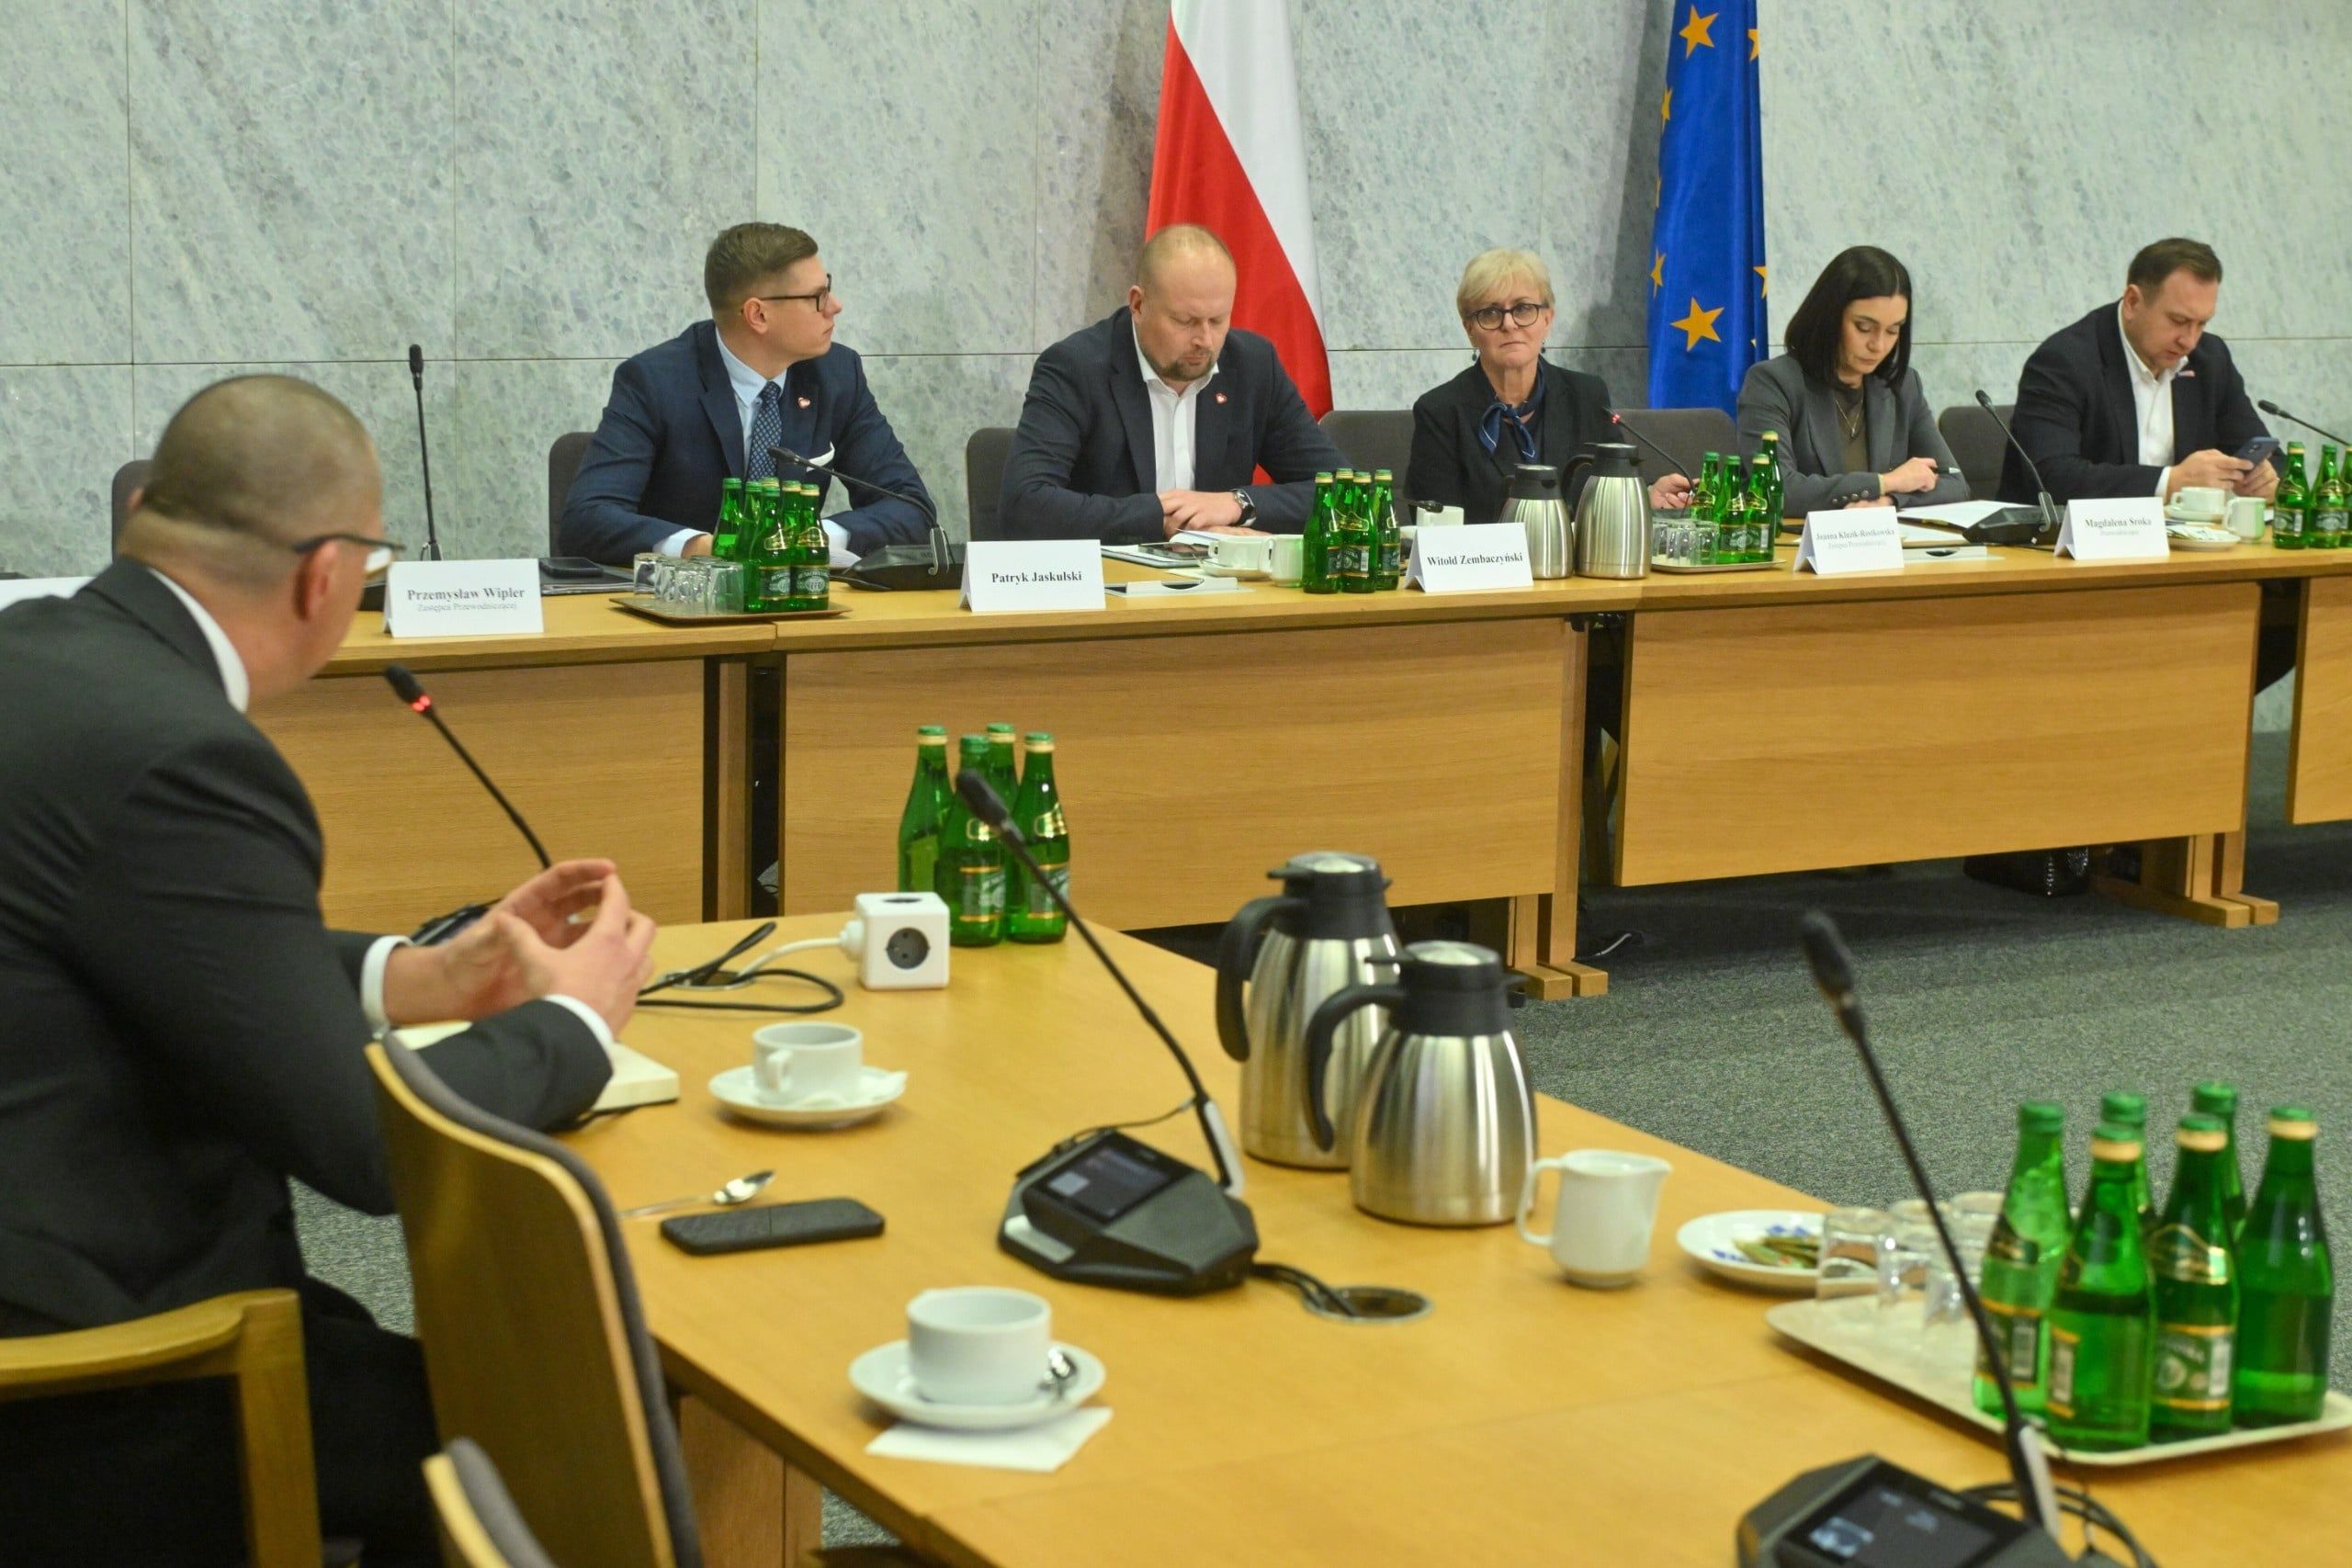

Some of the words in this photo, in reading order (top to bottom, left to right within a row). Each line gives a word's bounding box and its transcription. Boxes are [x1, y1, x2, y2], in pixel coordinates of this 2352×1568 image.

[1427, 556, 1458, 566] Witold
[1459, 552, 1523, 565] Zembaczyński
[991, 572, 1029, 585] Patryk
[1032, 570, 1082, 582] Jaskulski
[482, 587, 526, 602] Wipler
